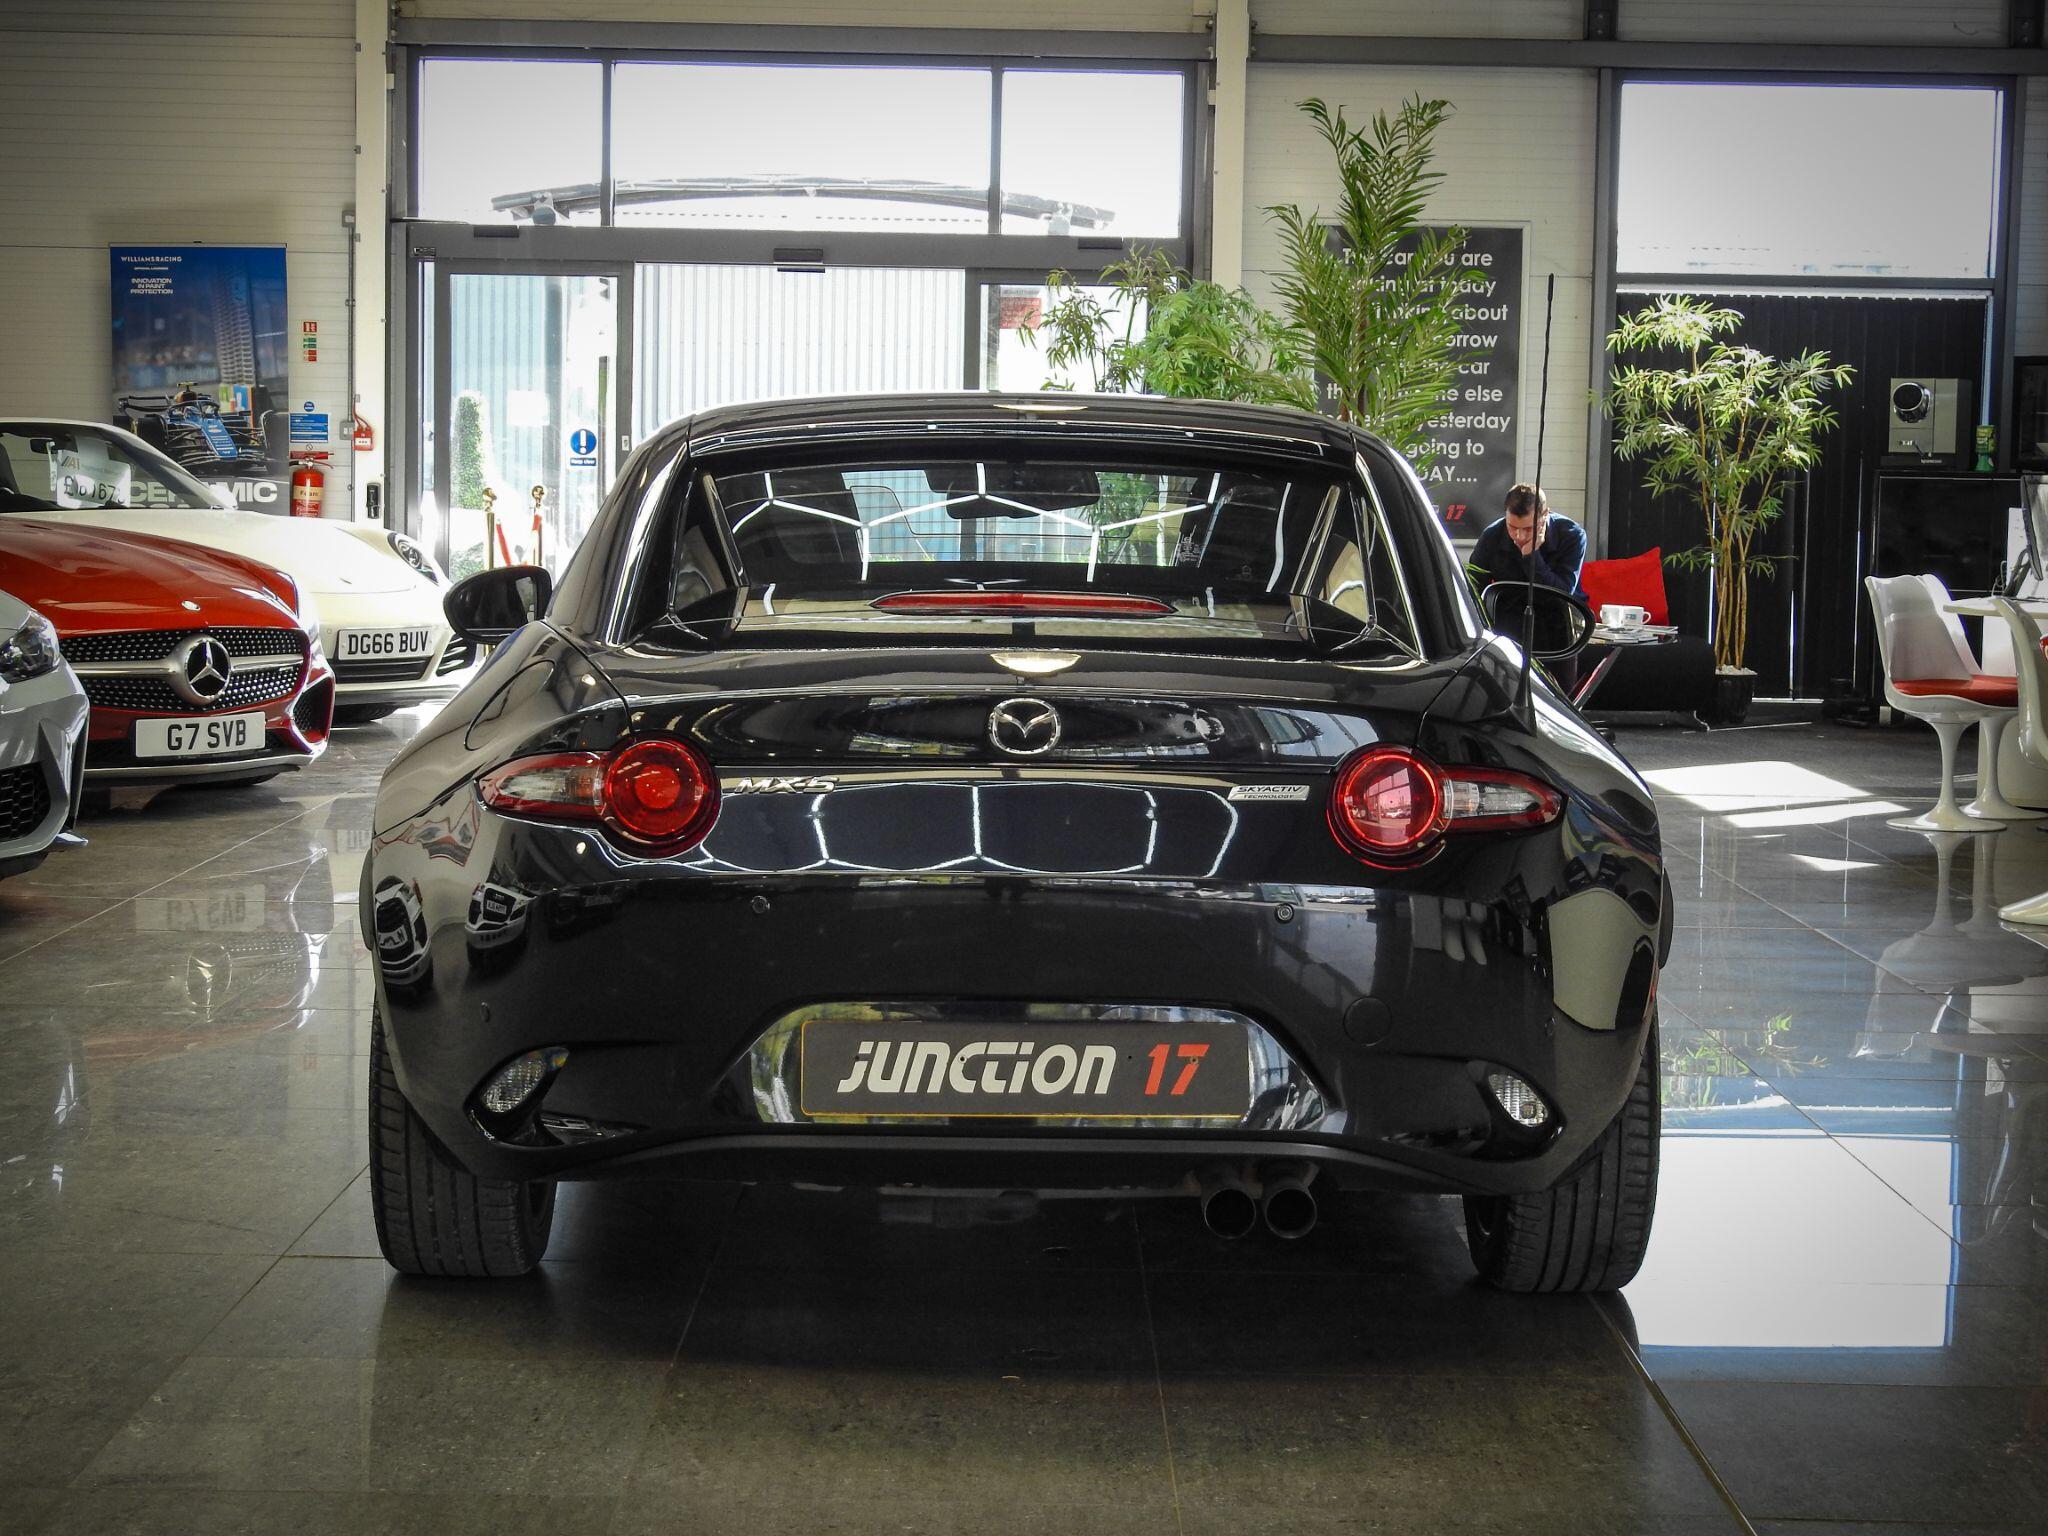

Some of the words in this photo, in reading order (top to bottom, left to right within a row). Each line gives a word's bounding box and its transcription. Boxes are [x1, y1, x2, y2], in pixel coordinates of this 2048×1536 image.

[1461, 252, 1493, 267] are
[1451, 303, 1509, 321] about
[1458, 361, 1490, 375] car
[1464, 385, 1503, 402] else
[1405, 438, 1460, 459] going
[1466, 439, 1485, 456] to
[130, 481, 278, 503] CEMIC
[1445, 504, 1467, 521] 17
[348, 632, 394, 656] DG66
[399, 630, 430, 652] BUV
[167, 723, 200, 751] G7
[207, 719, 246, 749] SVB
[734, 776, 840, 794] MX-5
[1144, 1043, 1210, 1096] 17
